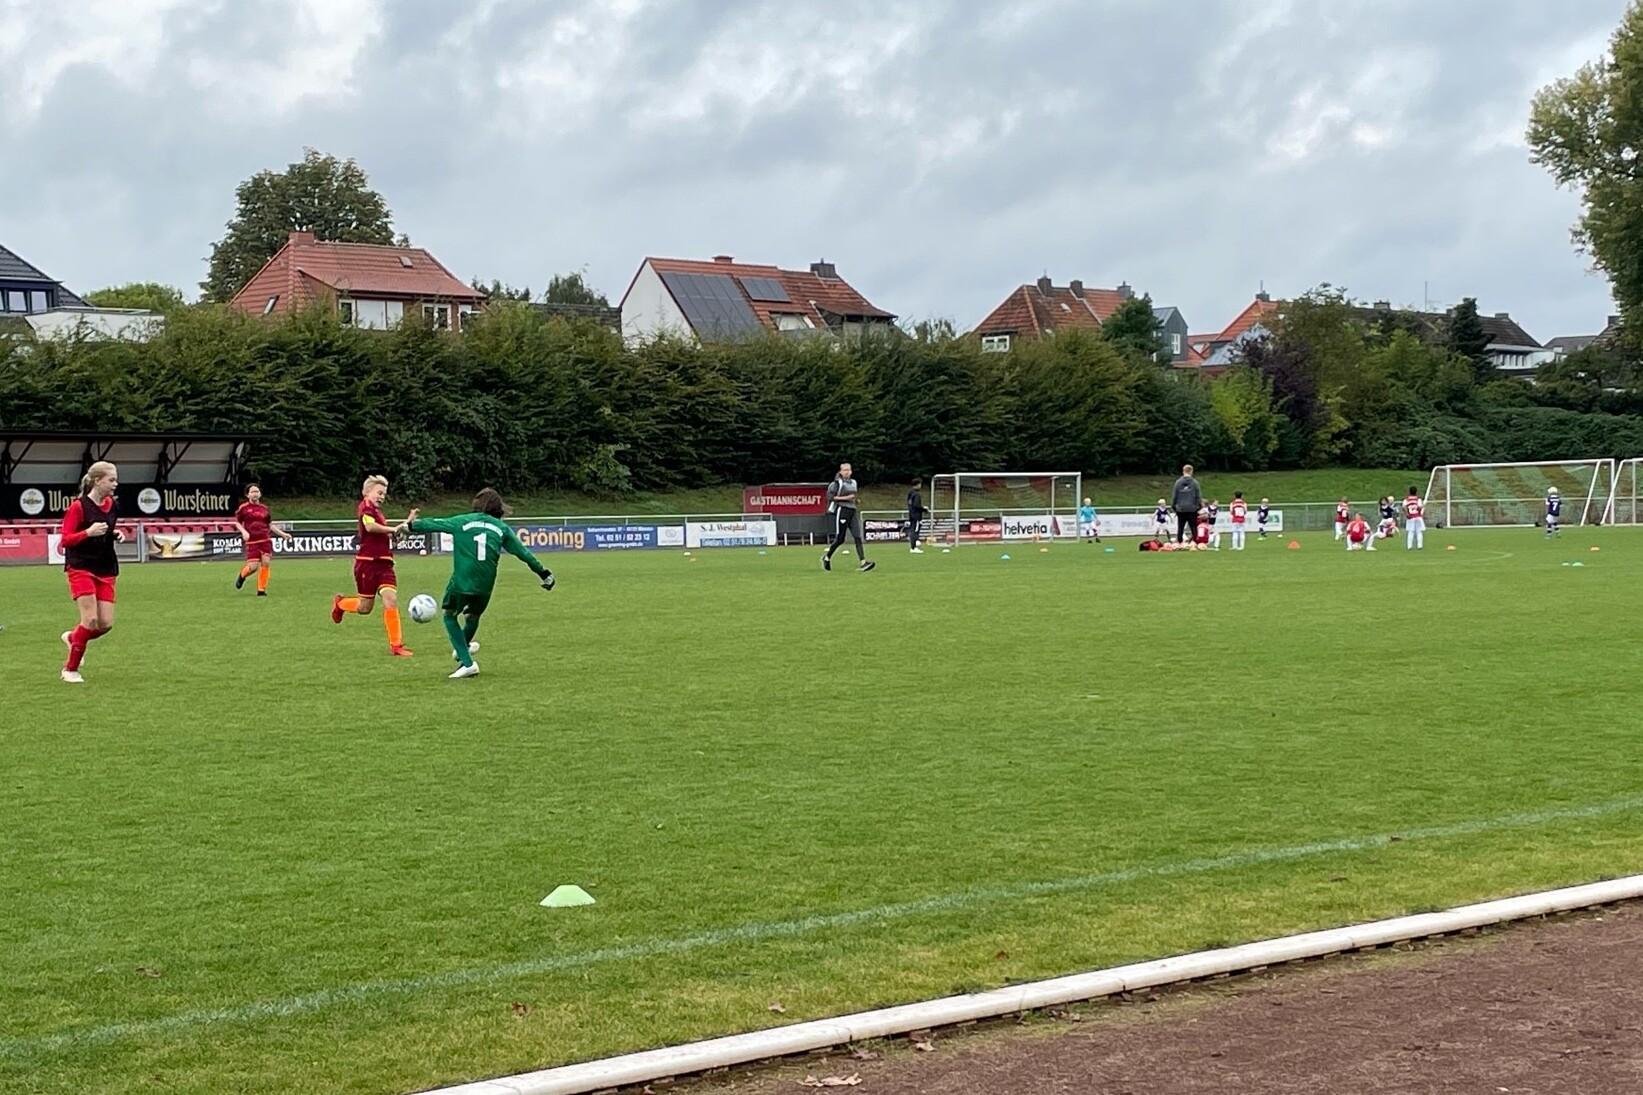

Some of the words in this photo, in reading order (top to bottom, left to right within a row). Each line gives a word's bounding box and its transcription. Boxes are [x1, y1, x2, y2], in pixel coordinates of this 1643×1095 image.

[164, 488, 230, 513] Warsteiner
[750, 496, 822, 506] GASTMANNSCHAFT
[1004, 521, 1047, 535] helvetia
[213, 538, 242, 548] KOMM
[473, 533, 487, 560] 1
[517, 528, 584, 549] Gröning
